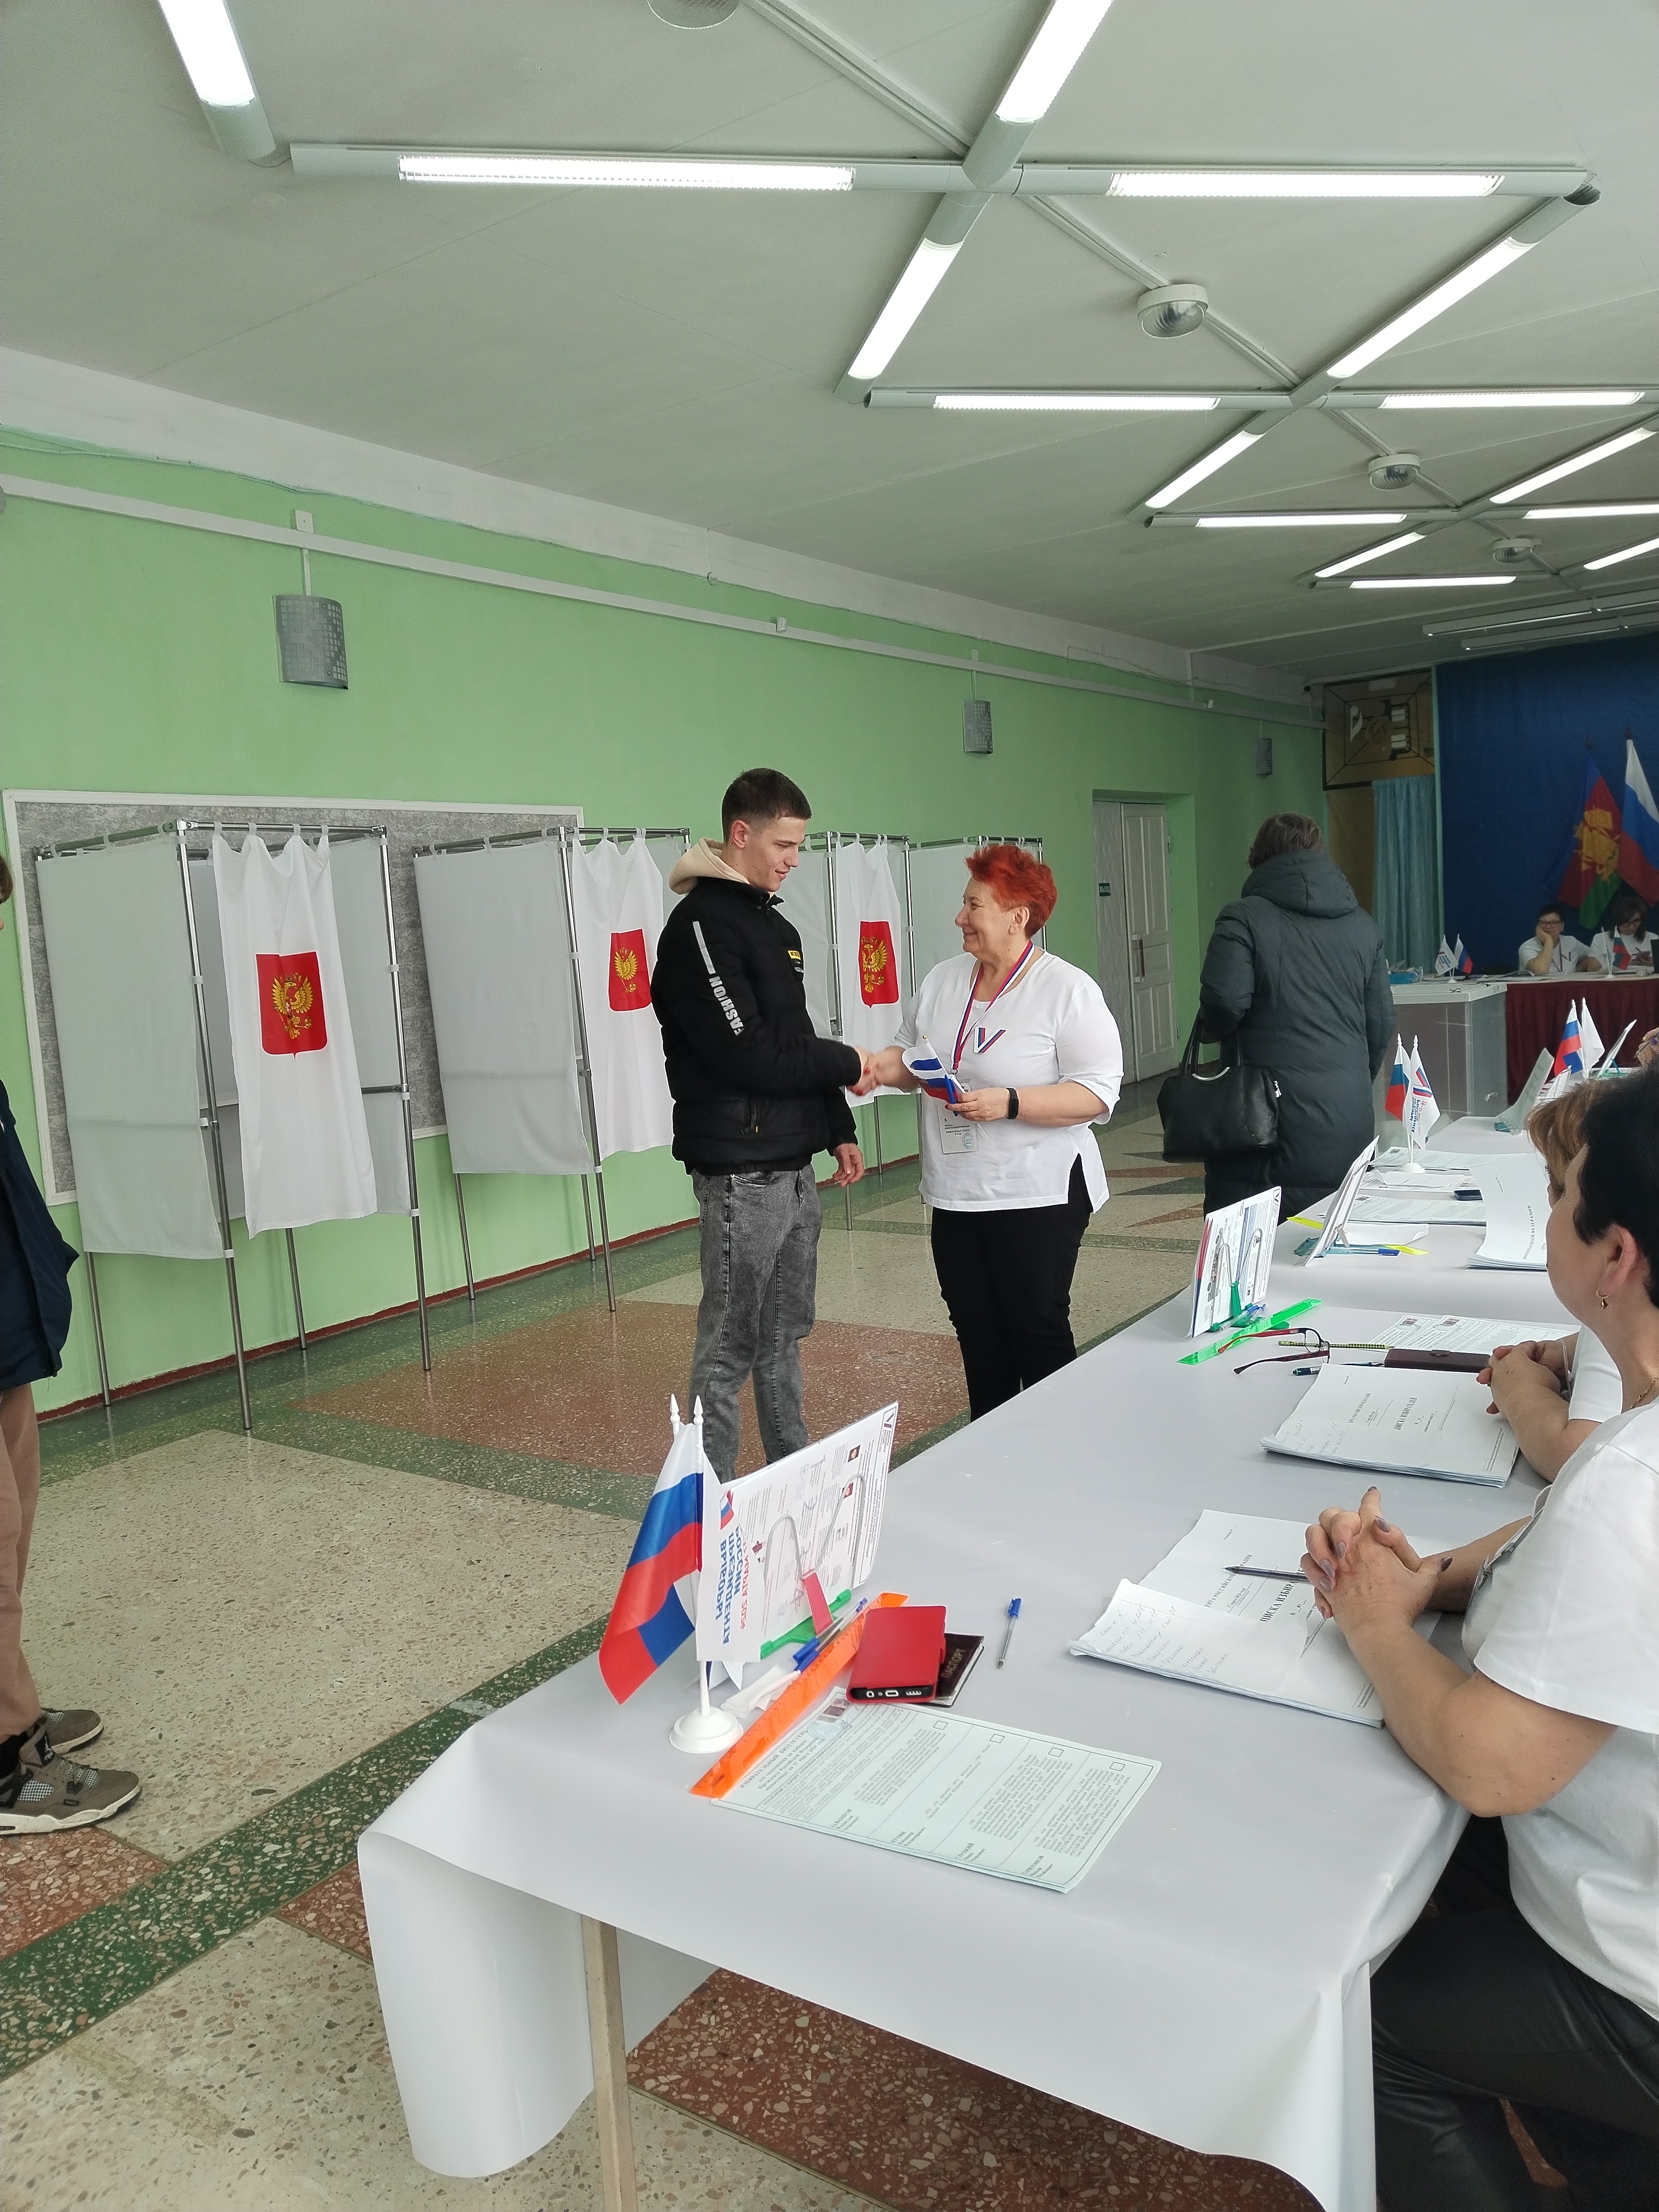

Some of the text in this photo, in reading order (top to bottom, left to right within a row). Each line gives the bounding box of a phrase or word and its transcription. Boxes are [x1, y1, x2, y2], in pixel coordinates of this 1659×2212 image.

[1260, 1602, 1282, 1622] ПИСКА
[941, 1647, 966, 1678] ПАСПОРТ
[738, 1754, 781, 1789] ИЗБИРАТЕЛЬНЫЙ
